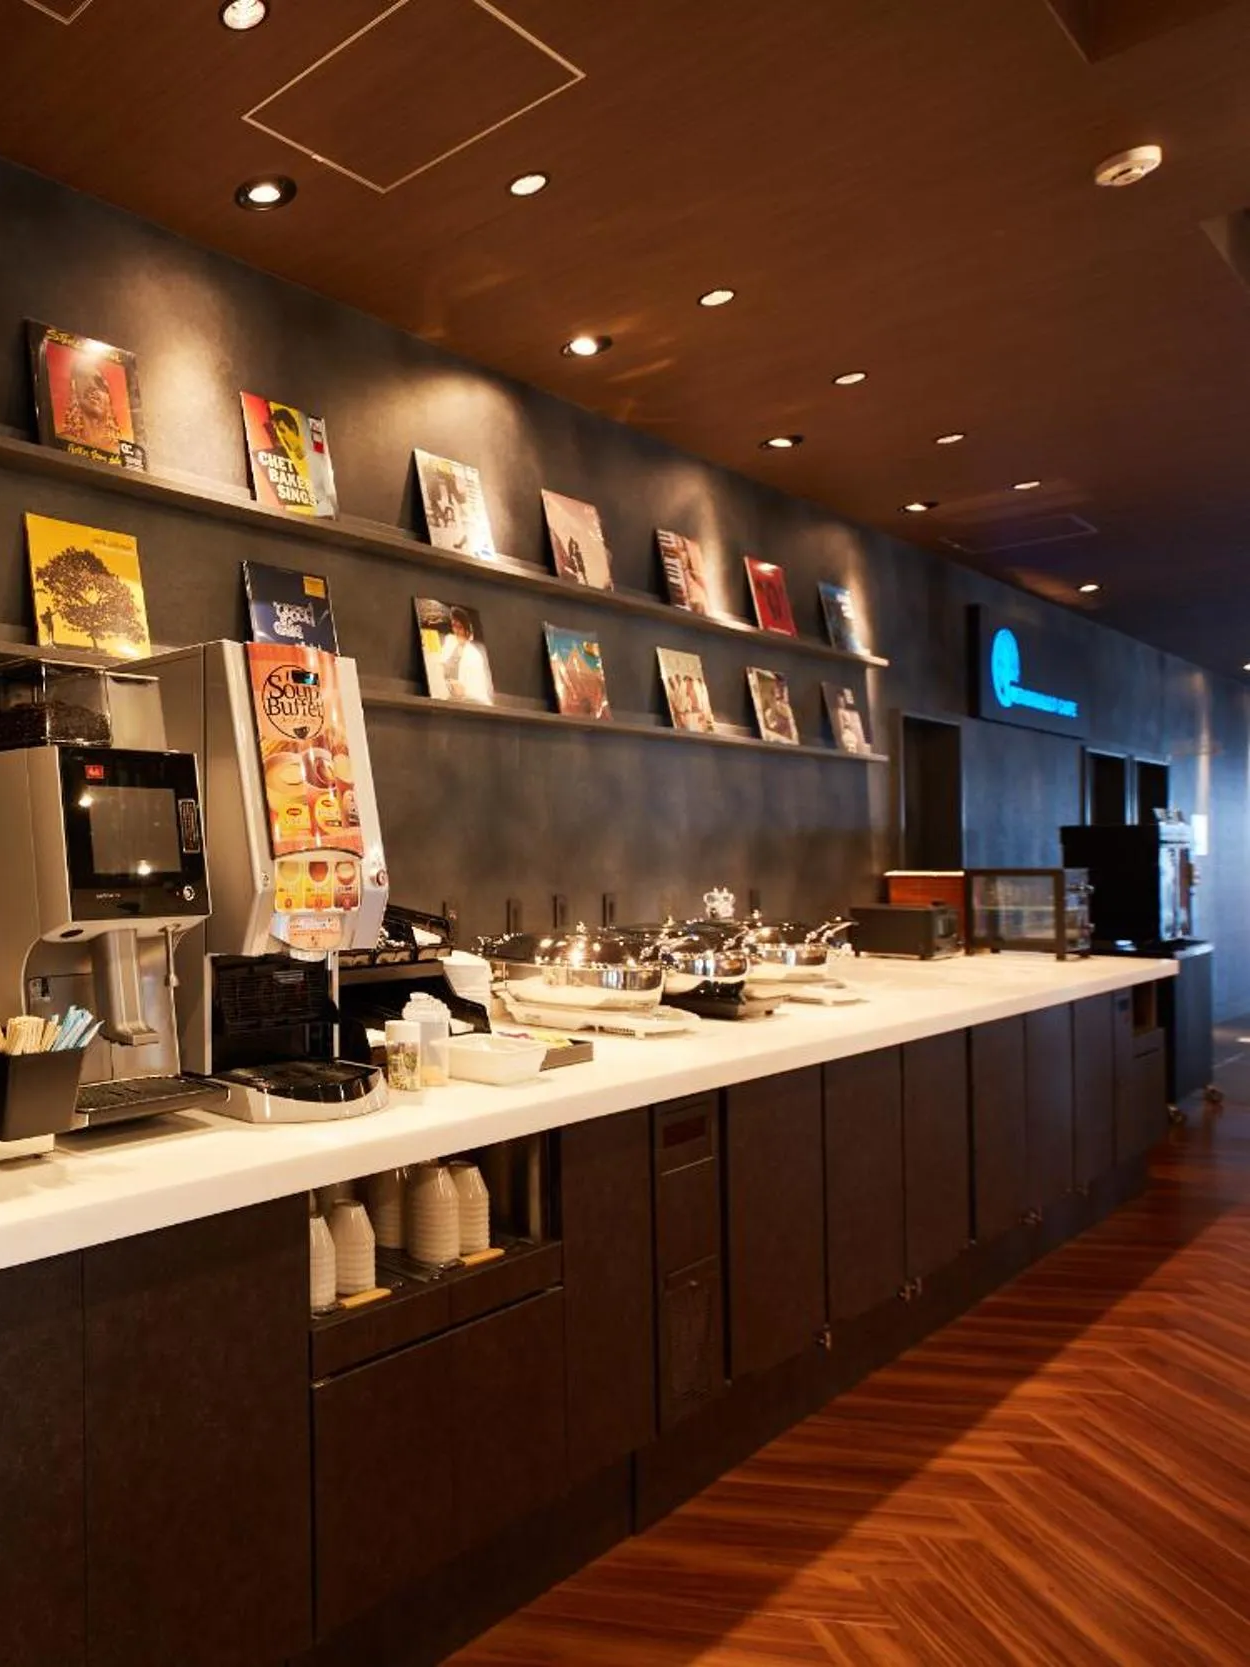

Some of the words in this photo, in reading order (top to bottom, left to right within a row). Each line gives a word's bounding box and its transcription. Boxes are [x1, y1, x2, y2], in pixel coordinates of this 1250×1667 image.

[258, 450, 294, 473] CHET
[268, 468, 311, 490] BAKER
[276, 484, 318, 504] SINGS
[266, 674, 320, 705] Soup
[266, 697, 325, 718] Buffet
